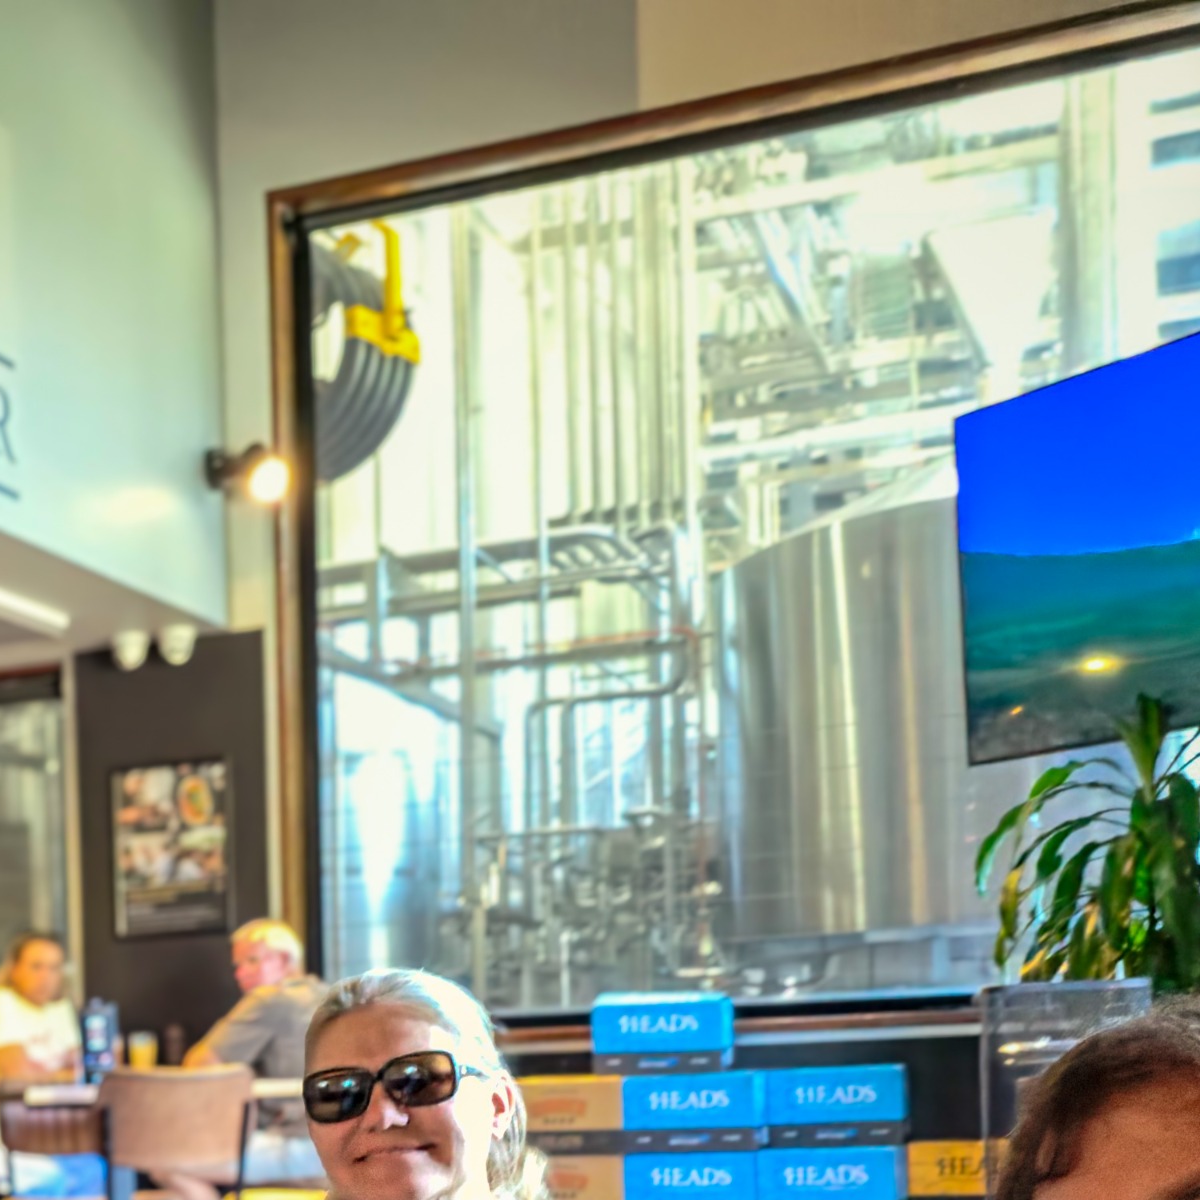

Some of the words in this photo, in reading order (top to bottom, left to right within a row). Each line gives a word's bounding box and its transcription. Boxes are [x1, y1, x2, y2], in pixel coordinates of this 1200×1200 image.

[618, 1013, 699, 1034] HEADS
[649, 1089, 730, 1111] HEADS
[795, 1084, 877, 1104] HEADS
[651, 1166, 732, 1187] HEADS
[783, 1163, 870, 1186] HEADS
